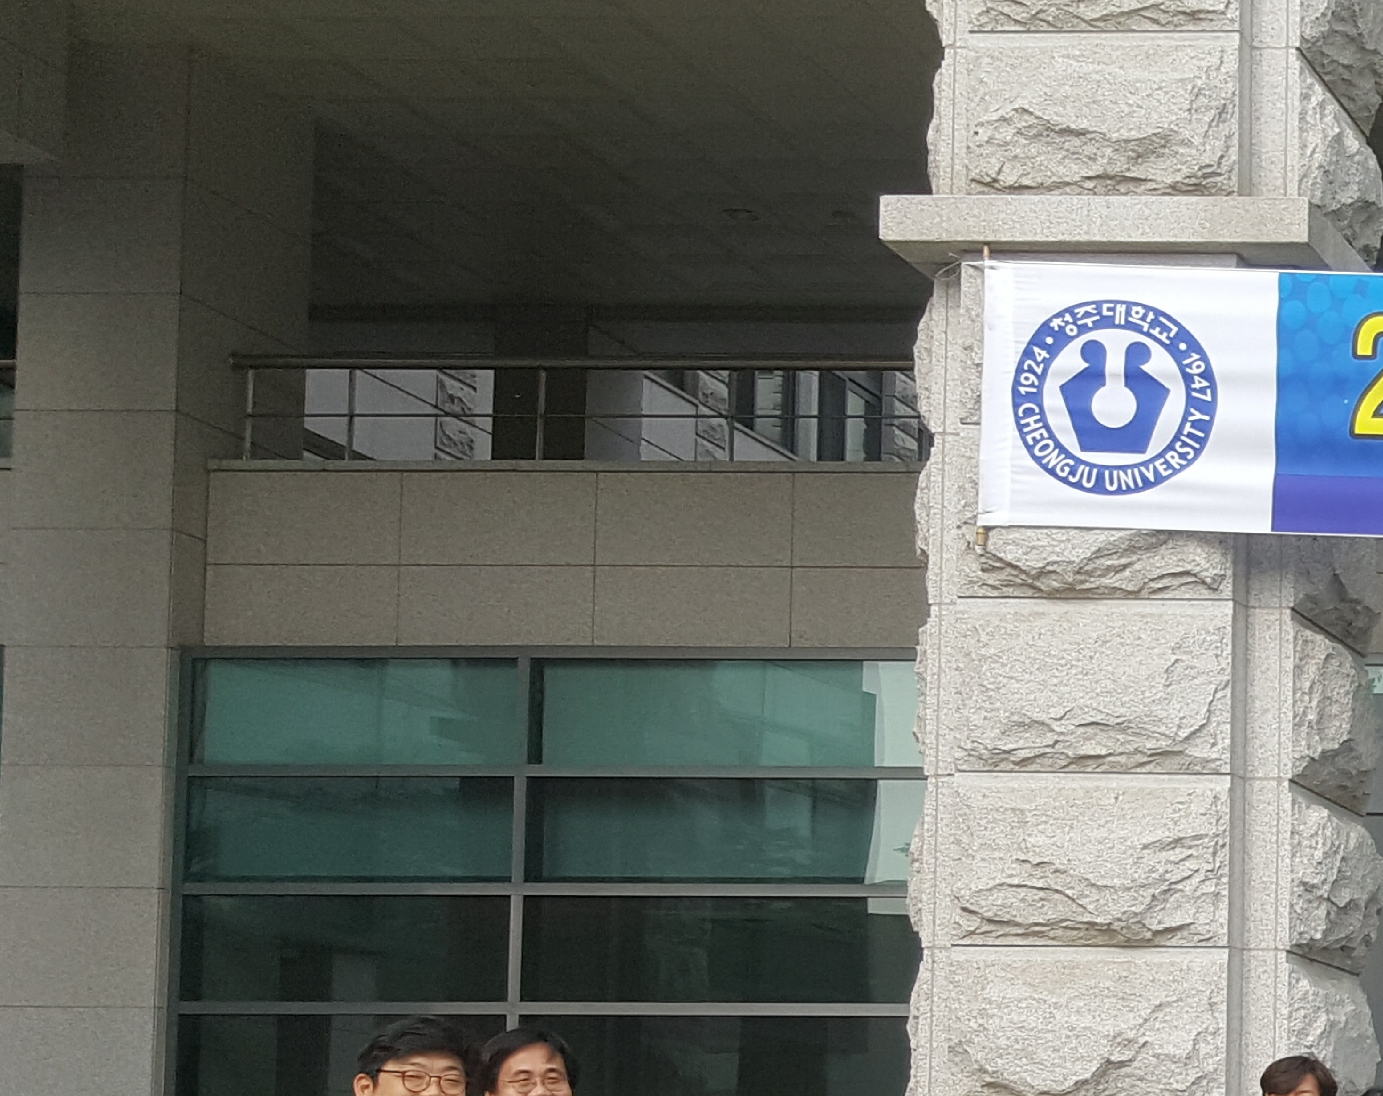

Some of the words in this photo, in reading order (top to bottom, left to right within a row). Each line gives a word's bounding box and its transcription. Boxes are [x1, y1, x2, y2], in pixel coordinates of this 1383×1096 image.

[1050, 303, 1179, 345] 청주대학교
[1017, 345, 1050, 395] 1924
[1182, 352, 1212, 402] 1947
[1017, 402, 1098, 489] CHEONGJU
[1103, 407, 1211, 492] UNIVERSITY
